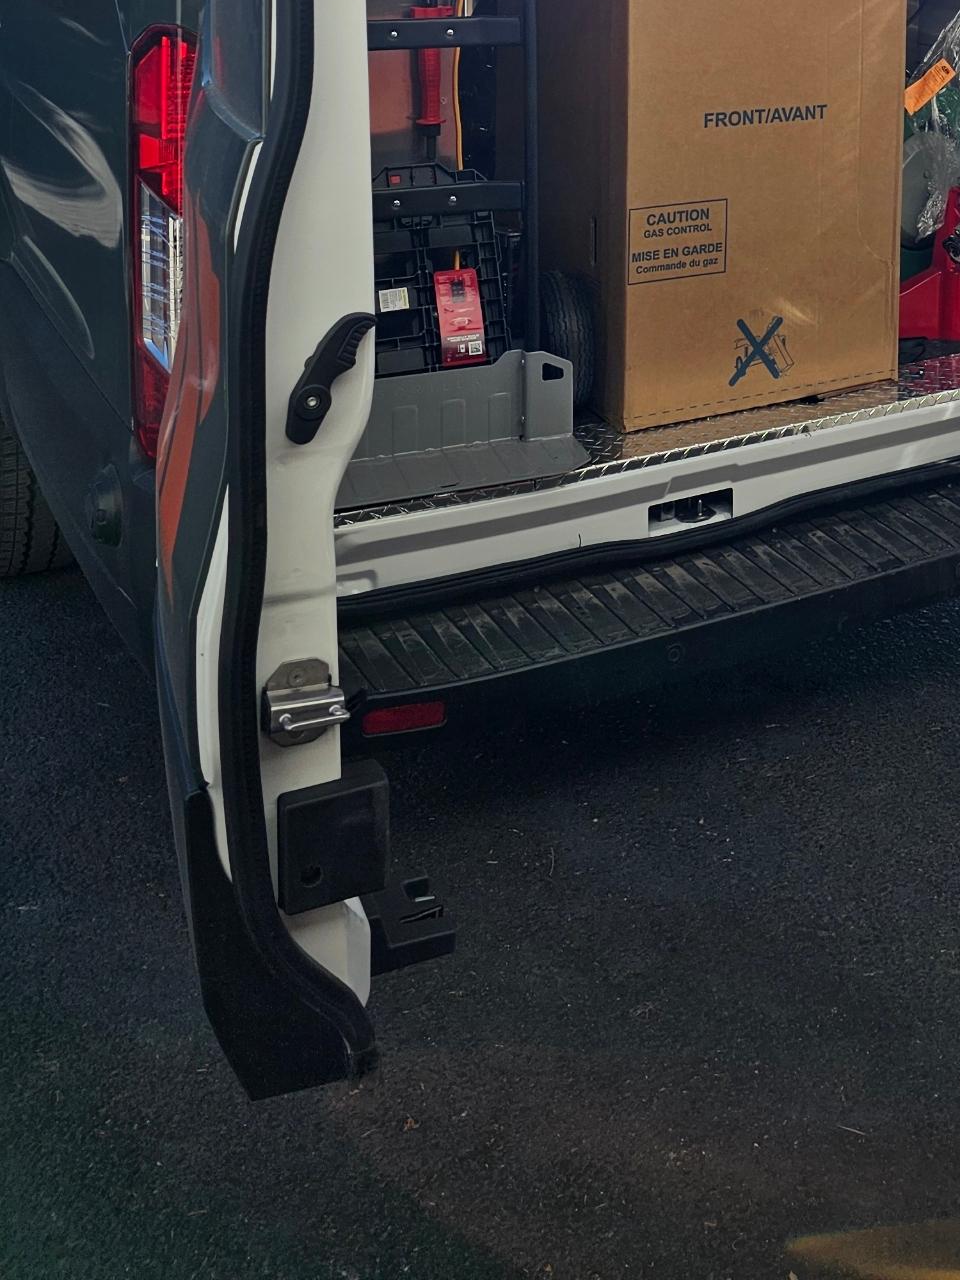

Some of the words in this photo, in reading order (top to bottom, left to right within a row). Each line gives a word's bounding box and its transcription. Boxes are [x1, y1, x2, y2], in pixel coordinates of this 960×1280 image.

[704, 104, 828, 128] FRONT/AVANT
[646, 208, 710, 226] CAUTION
[644, 228, 664, 239] GAS
[667, 223, 712, 237] CONTROL
[632, 249, 660, 263] MISE
[663, 247, 679, 260] EN
[682, 242, 723, 257] GARDE
[636, 260, 687, 275] Commande
[689, 257, 701, 268] du
[703, 256, 719, 267] gaz
